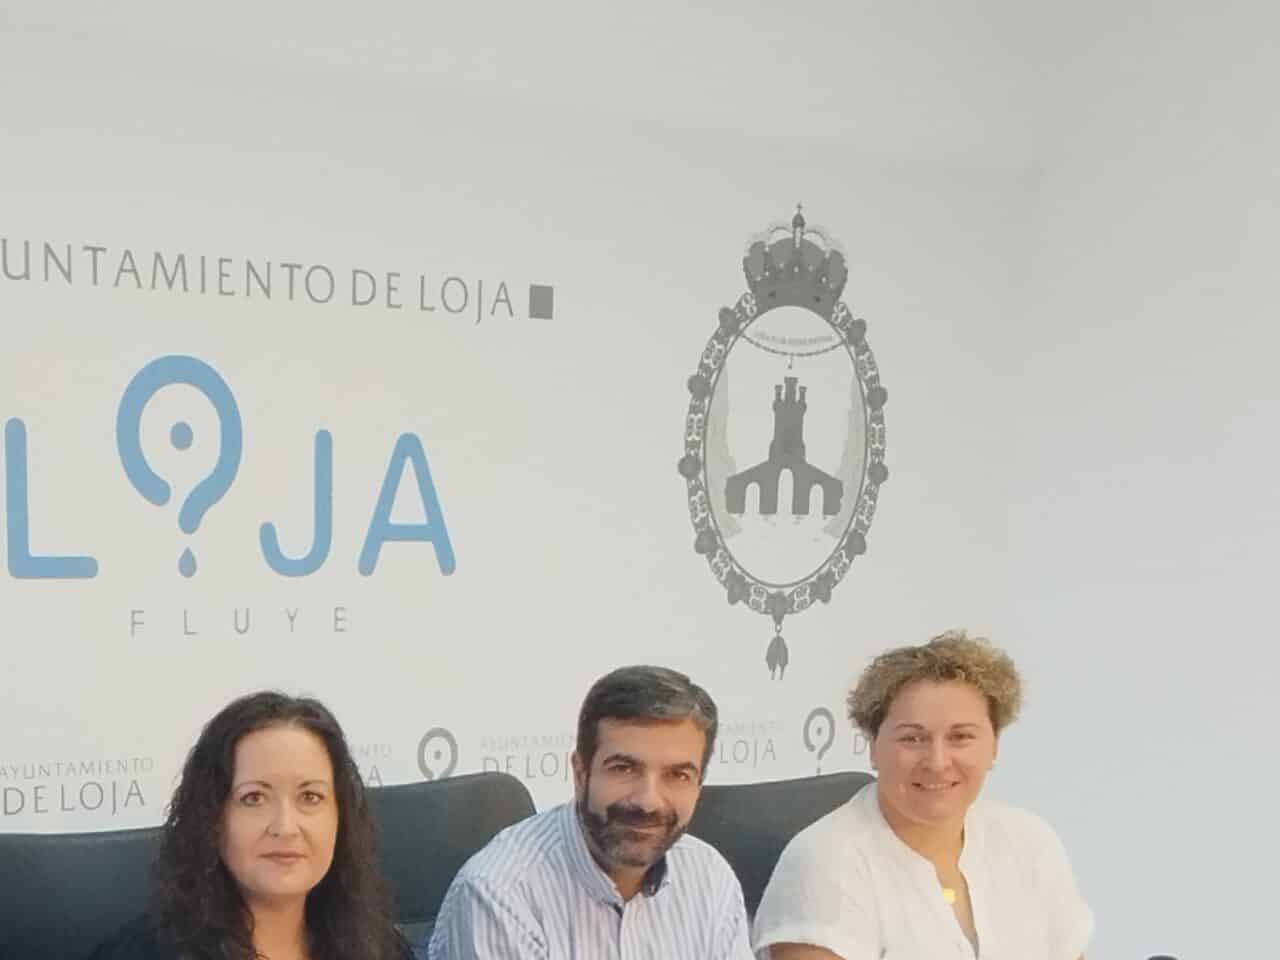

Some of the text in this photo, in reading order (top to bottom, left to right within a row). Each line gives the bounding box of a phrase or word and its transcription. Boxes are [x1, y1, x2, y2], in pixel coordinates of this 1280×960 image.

[351, 268, 404, 310] DE
[418, 276, 516, 325] LOJA
[4, 354, 456, 579] LOJA
[130, 606, 348, 638] FLUYE
[525, 752, 571, 782] LOJ
[3, 779, 145, 816] DE LOJA
